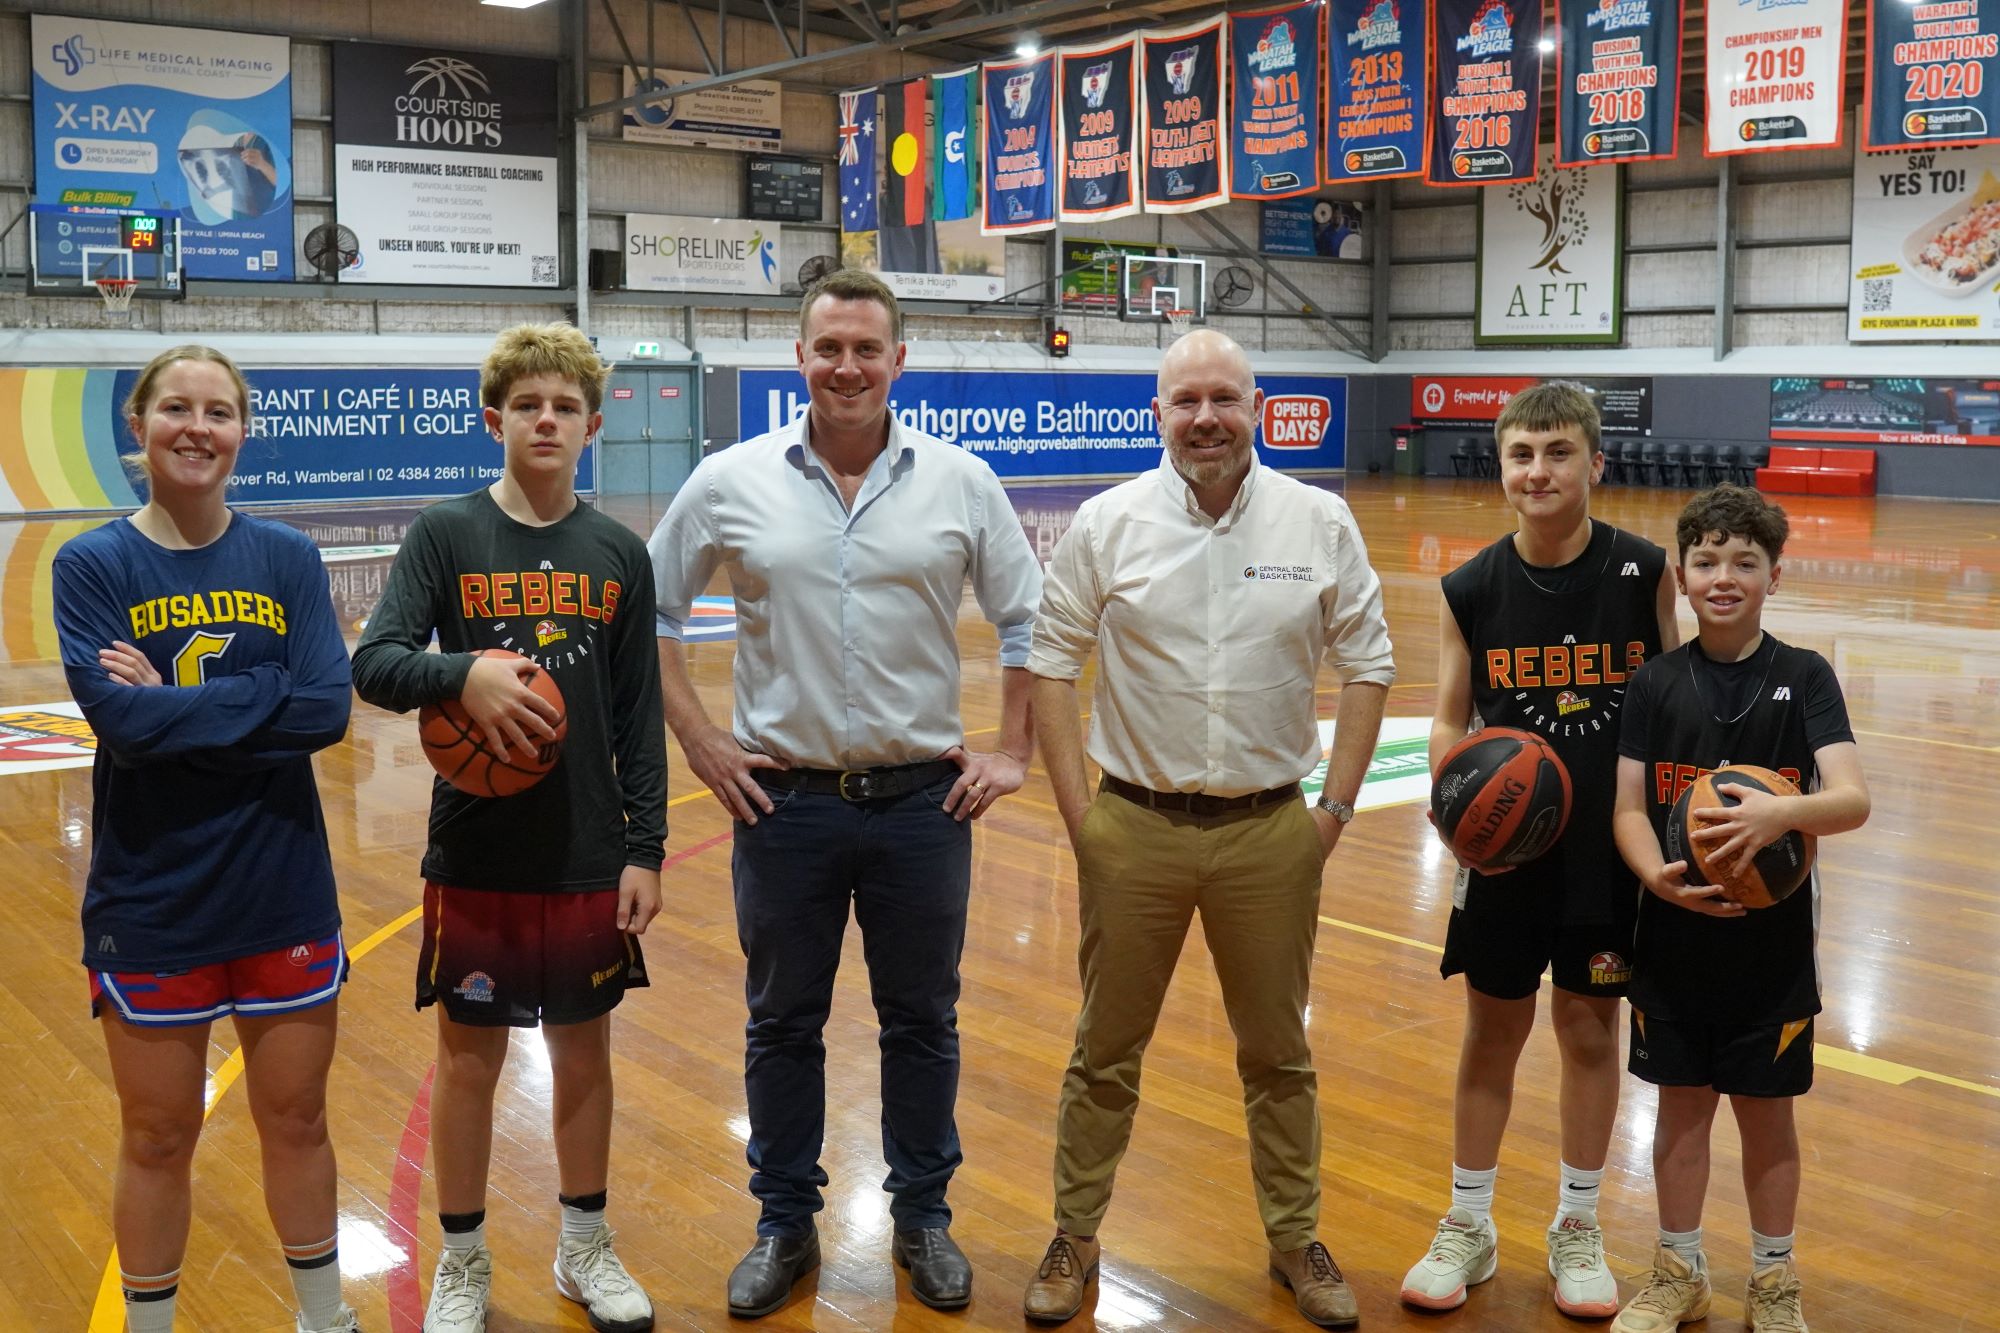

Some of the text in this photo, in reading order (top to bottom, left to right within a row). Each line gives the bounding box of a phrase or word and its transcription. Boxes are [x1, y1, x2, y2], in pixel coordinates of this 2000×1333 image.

[1587, 0, 1647, 27] WARATAH
[1912, 2, 1970, 21] WARATAH
[1604, 13, 1650, 32] LEAGUE
[1913, 18, 1979, 39] YOUTH MEN
[1347, 21, 1398, 46] WARATAH
[1362, 30, 1401, 50] LEAGUE
[1456, 28, 1511, 51] WARATAH
[1725, 25, 1823, 49] CHAMPIONSHIP MEN
[1248, 42, 1295, 67] WARATAH
[1472, 38, 1513, 57] LEAGUE
[1593, 36, 1641, 56] DIVISION 1
[1894, 34, 1998, 65] CHAMPIONS
[100, 49, 272, 72] LIFE MEDICAL IMAGING
[1259, 53, 1296, 72] LEAGUE
[1350, 51, 1403, 86] 2013
[1458, 60, 1511, 79] DIVISION 1
[1592, 51, 1643, 72] YOUTH MEN
[1745, 46, 1805, 82] 2019
[145, 65, 231, 78] CENTRAL COAST
[1577, 65, 1657, 94] CHAMPIONS
[1905, 60, 1983, 102] 2020
[1252, 71, 1300, 107] 2011
[1457, 76, 1512, 95] YOUTH MEN
[1730, 81, 1814, 107] CHAMPIONS
[394, 95, 502, 118] COURTSIDE
[1163, 96, 1201, 124] 2009
[1443, 90, 1526, 116] CHAMPIONS
[1589, 88, 1645, 126] 2018
[55, 102, 155, 133] X-RAY
[1079, 110, 1114, 136] 2009
[1338, 113, 1413, 139] CHAMPIONS
[1927, 112, 1971, 124] Basketball
[395, 115, 502, 147] HOOPS
[1004, 125, 1036, 152] 2004
[1455, 115, 1511, 149] 2016
[85, 147, 152, 158] OPEN SATURDAY
[85, 155, 138, 165] AND SUNDAY
[1363, 151, 1394, 162] Basketball
[1471, 156, 1504, 166] Basketball
[352, 159, 543, 181] HIGH PERFORMANCE BASKETBALL COACHING
[751, 162, 772, 172] LIGHT
[802, 166, 822, 176] DARK
[1908, 155, 1935, 171] SAY
[412, 182, 487, 193] INDIVIDUAL SESSIONS
[1879, 169, 1966, 197] YES TO!
[63, 191, 132, 206] Bulk Billing
[417, 196, 484, 207] PARTNER SESSIONS
[407, 210, 493, 221] SMALL GROUP SESSIONS
[1265, 209, 1289, 219] BETTER
[76, 226, 106, 234] BATEAU
[132, 232, 153, 247] 24
[407, 224, 493, 235] LARGE GROUP SESSIONS
[197, 248, 239, 256] 4326 7000
[379, 239, 521, 256] UNSEEN HOURS. YOU'RE UP NEXT!
[630, 234, 745, 268] SHORELINE
[682, 259, 745, 271] SPORTS FLOORS
[894, 274, 958, 287] Tenika Hough
[1505, 282, 1588, 317] AFT
[1879, 319, 1917, 328] FOUNTAIN
[1920, 318, 1946, 328] PLAZA
[1956, 317, 1977, 327] MINS
[1055, 334, 1067, 346] 24
[337, 384, 400, 410] CAFÉ
[423, 388, 470, 409] BAR
[1454, 388, 1497, 405] Equipped for
[1273, 402, 1321, 418] OPEN 6
[245, 413, 476, 438] RTAINMENT GOLF
[890, 399, 1156, 443] ighgrove Bathroom
[1272, 419, 1321, 442] DAYS
[961, 435, 1166, 455] www.highgrovebathrooms.com.a
[1879, 433, 1966, 444] Now at HOYTS Erina
[266, 471, 291, 487] Rd,
[295, 468, 364, 484] Wamberal
[376, 468, 393, 482] 02
[397, 467, 430, 481] 4384
[434, 467, 465, 480] 2661
[1259, 573, 1314, 582] BASKETBALL
[460, 571, 621, 625] REBELS
[538, 629, 567, 648] REBELS
[1487, 641, 1645, 689] REBELS
[1515, 689, 1625, 737] BASKETBALL
[1558, 700, 1591, 717] REBELS
[453, 986, 492, 996] WARATAH
[464, 993, 495, 1002] LEAGUE
